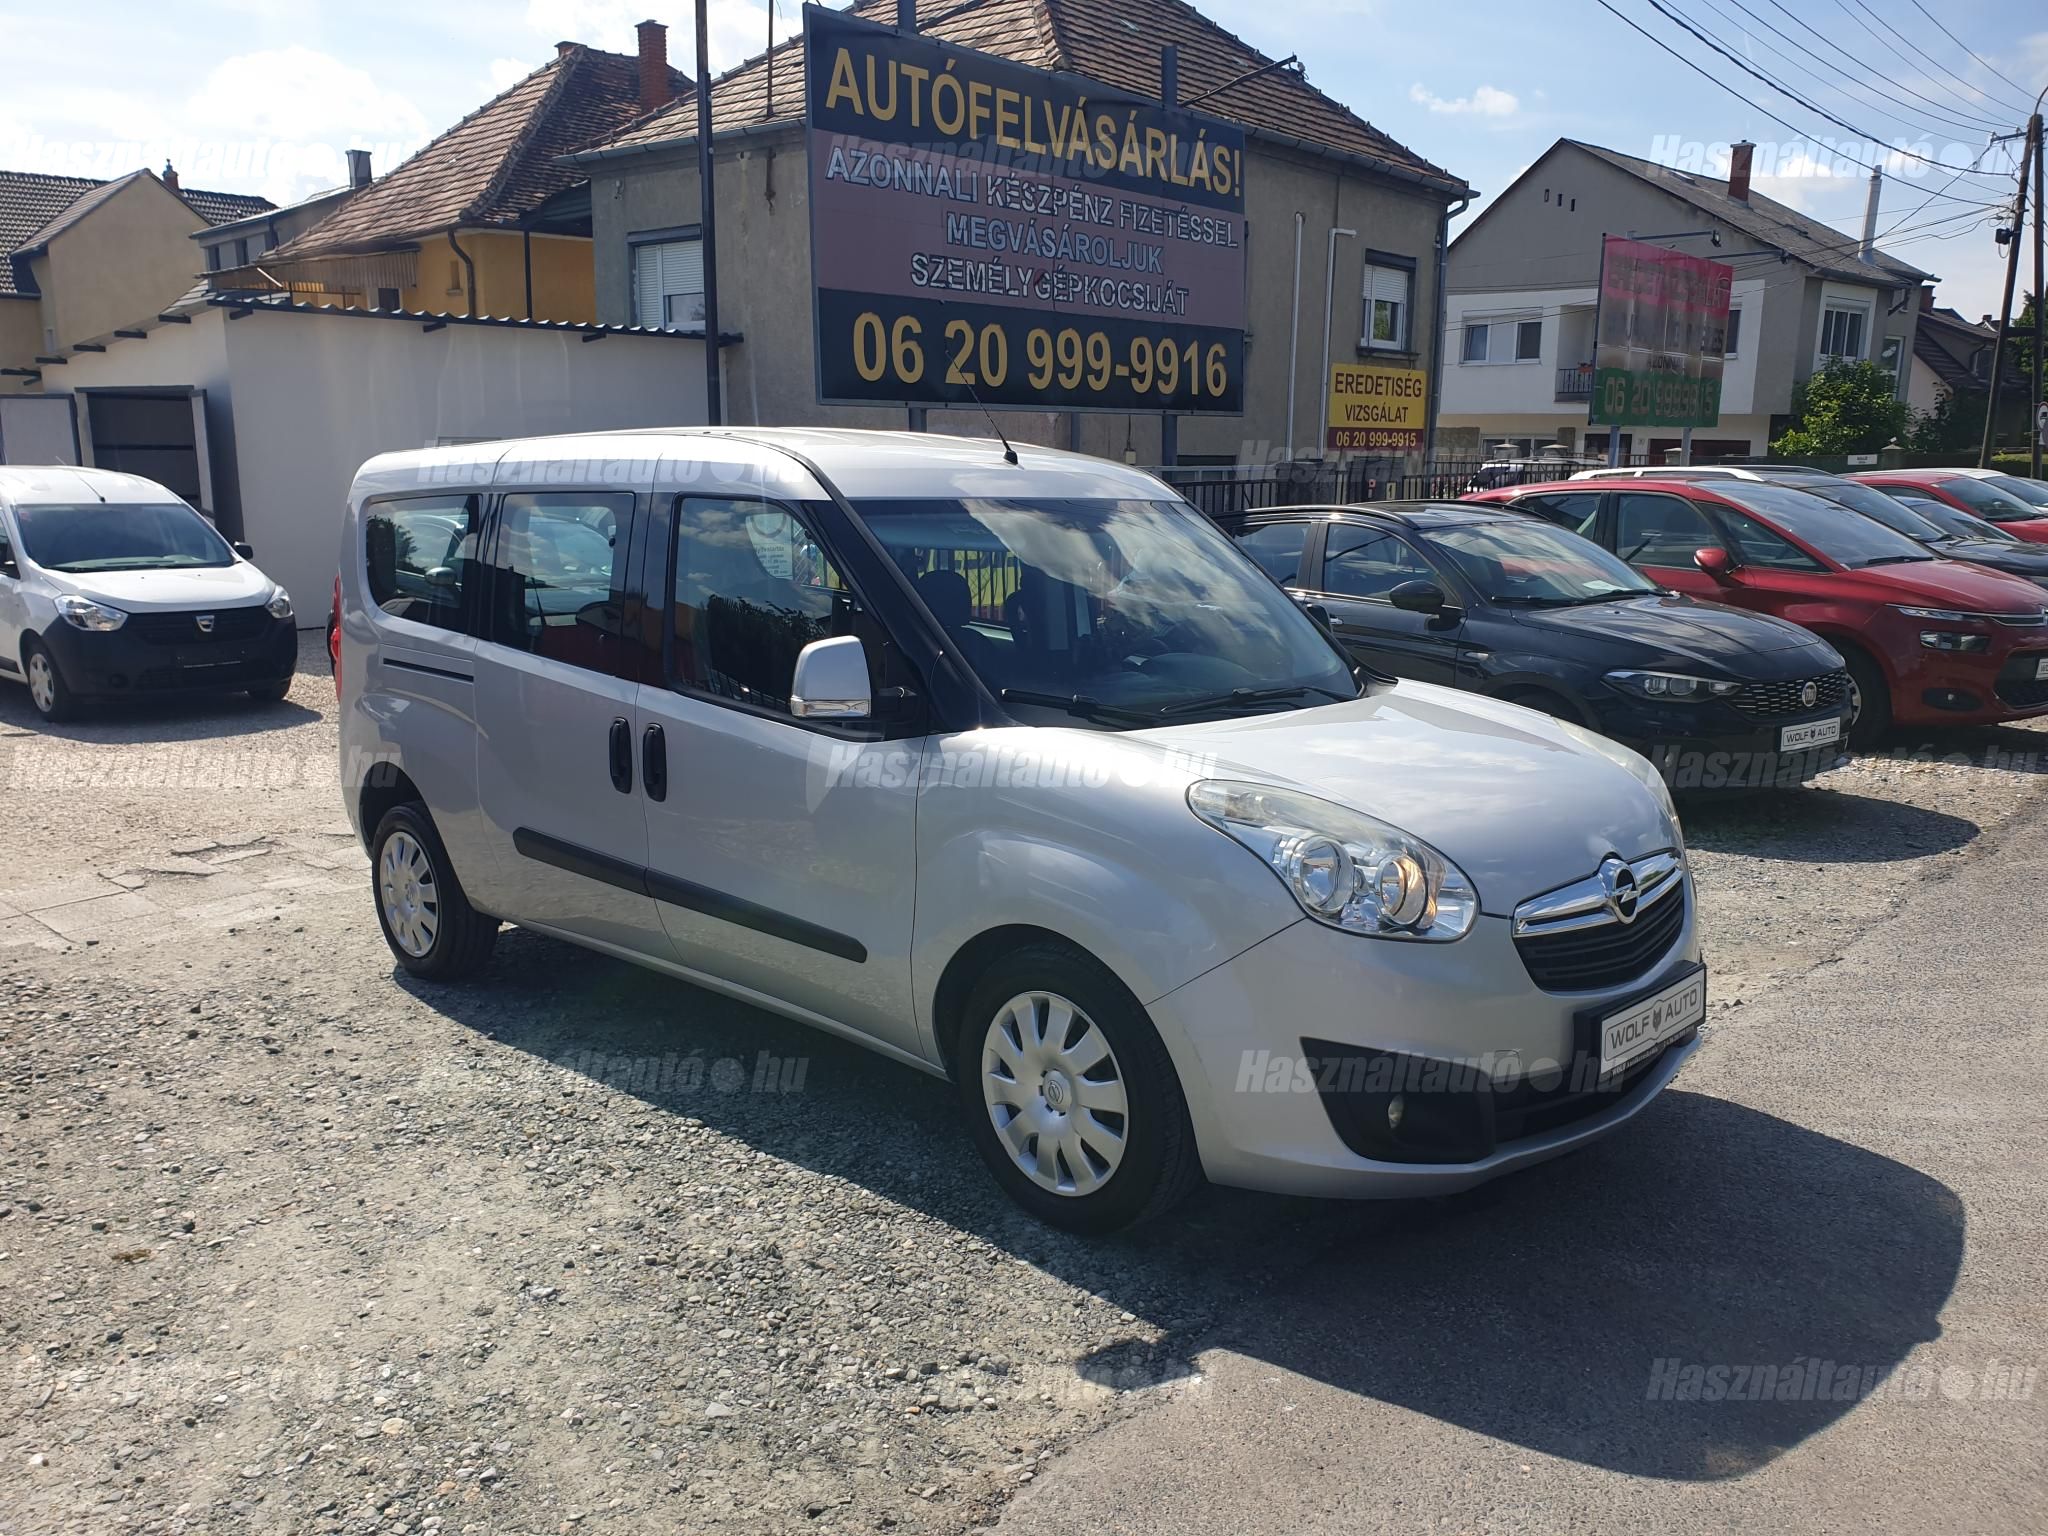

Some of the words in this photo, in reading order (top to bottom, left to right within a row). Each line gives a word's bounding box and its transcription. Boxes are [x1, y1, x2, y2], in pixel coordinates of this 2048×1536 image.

[825, 47, 1242, 197] AUTÓFELVÁSÁRLÁS!
[826, 147, 978, 203] AZONNALI
[986, 175, 1114, 226] KÉSZPÉNZ
[1119, 200, 1239, 249] FIZETÉSSEL
[946, 212, 1163, 275] MEGVÁSÁROLJUK
[853, 311, 925, 384] 06
[944, 319, 1008, 389] 20
[1026, 327, 1227, 398] 999-9916
[1334, 372, 1422, 398] EREDETISÉG
[1604, 376, 1626, 416] 06
[1345, 402, 1409, 423] VIZSGÁLAT
[1336, 431, 1350, 447] 06
[1352, 431, 1366, 447] 20
[1369, 431, 1417, 448] 999-9915
[1786, 730, 1808, 743] WOLF
[1818, 725, 1837, 737] AUTO
[1610, 1014, 1650, 1049] WOLF
[1665, 988, 1698, 1022] AUTO
